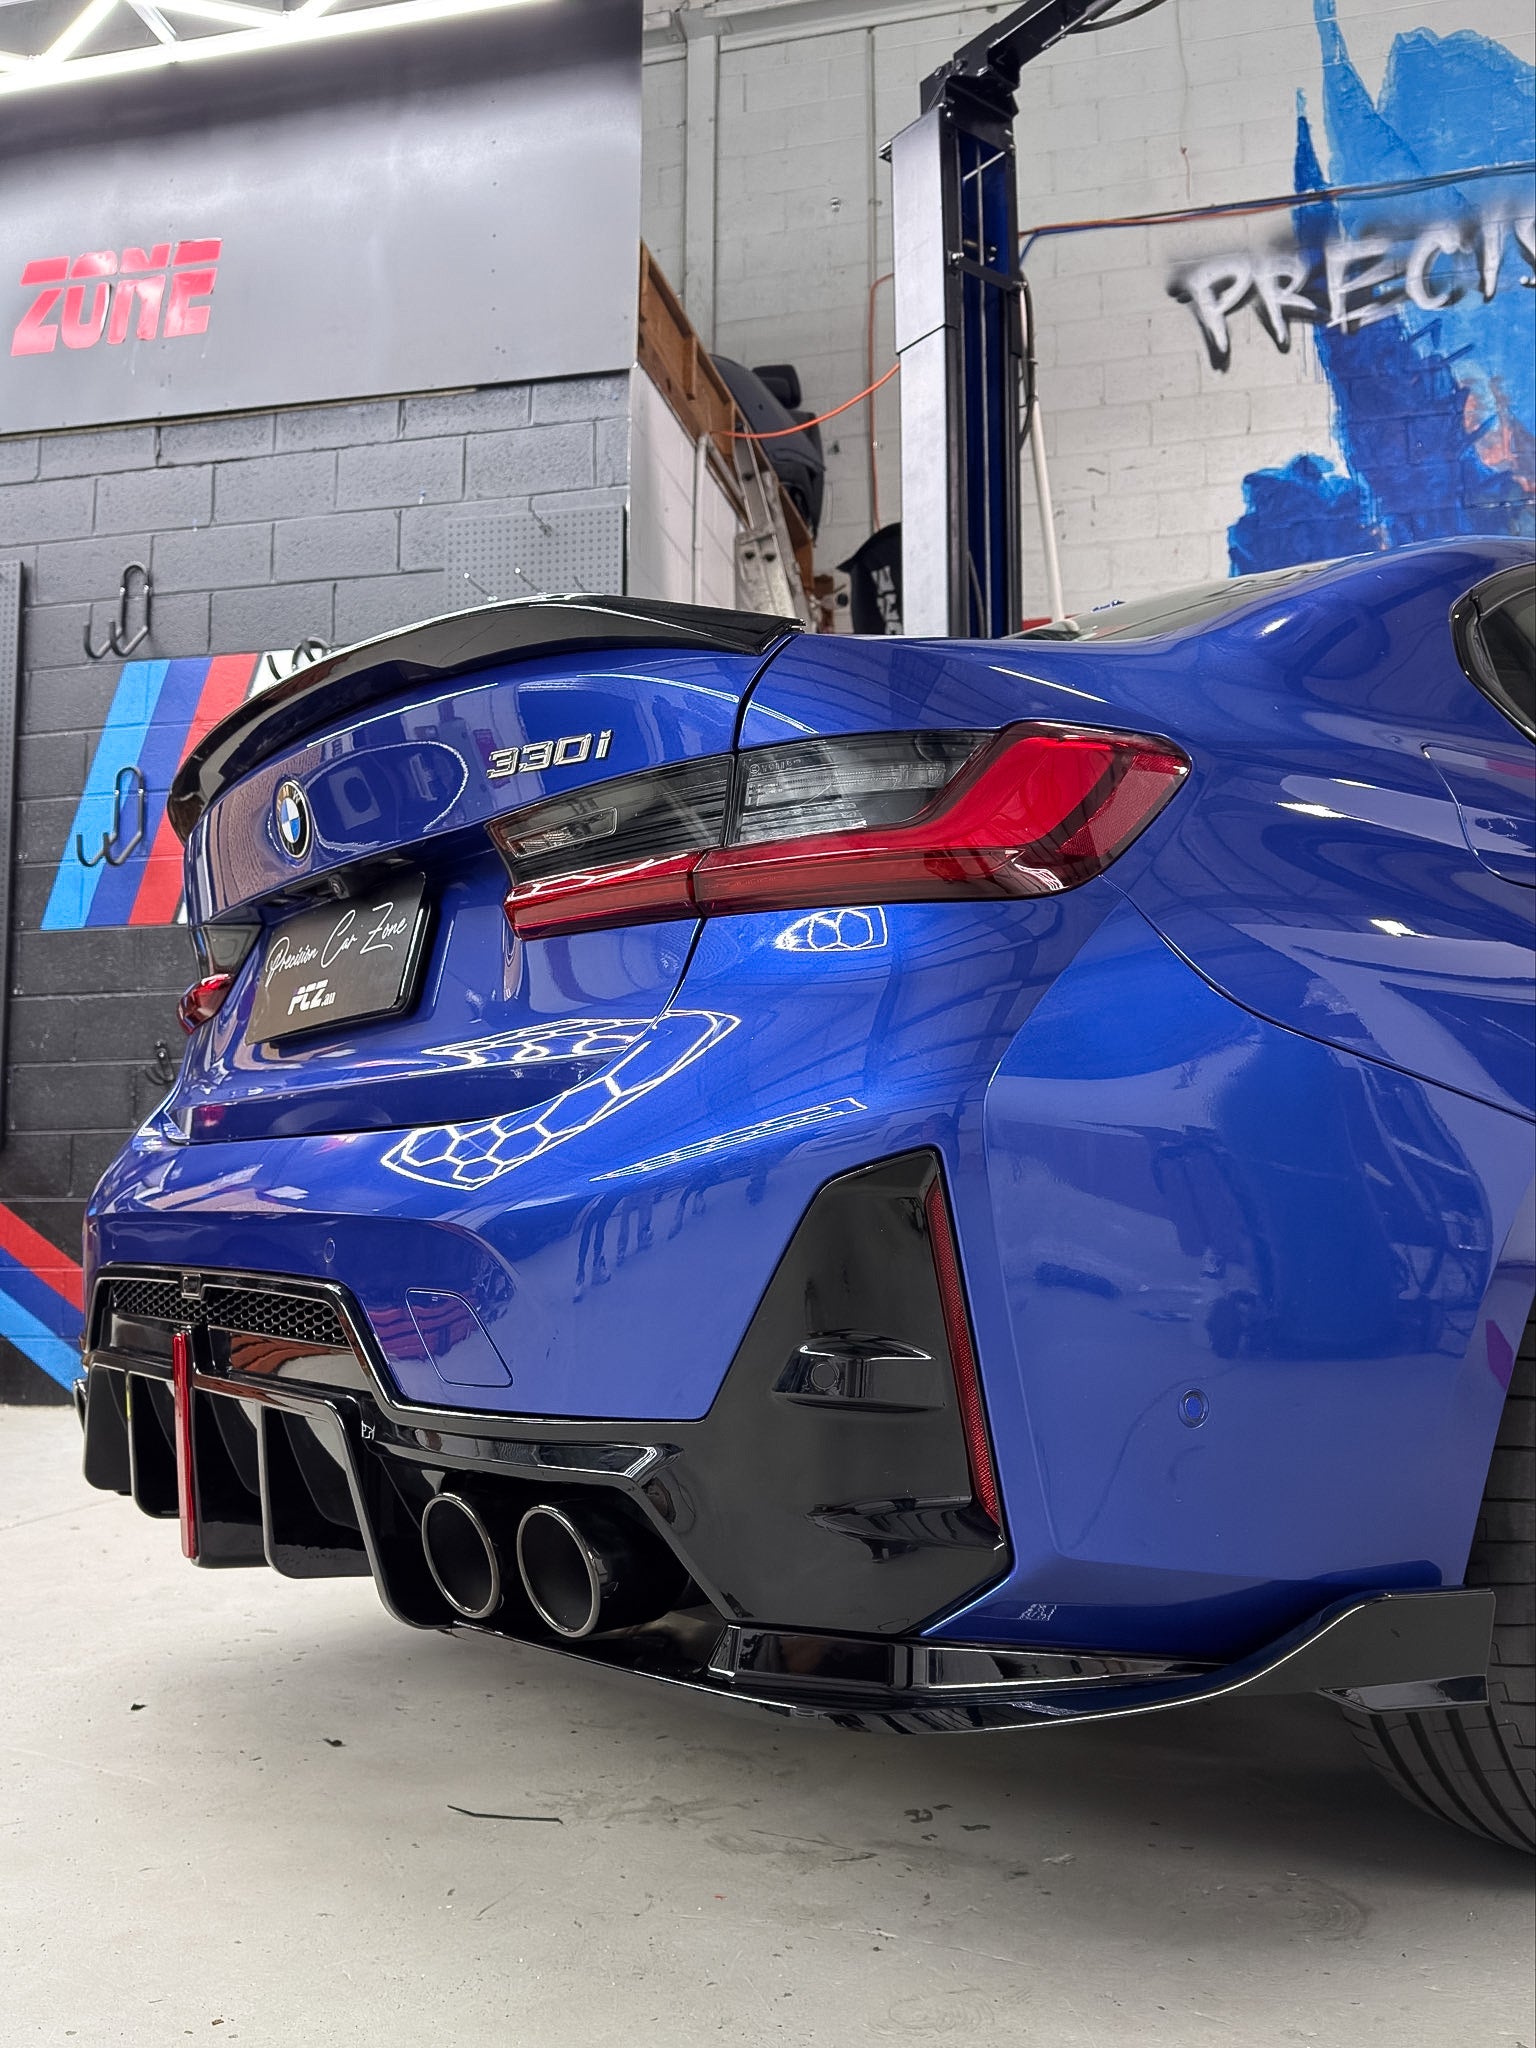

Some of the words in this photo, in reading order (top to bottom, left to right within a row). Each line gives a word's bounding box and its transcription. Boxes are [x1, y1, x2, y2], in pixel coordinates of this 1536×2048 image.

[11, 237, 222, 356] ZONE
[486, 729, 613, 779] 330i
[265, 936, 318, 987] Precision
[320, 909, 357, 968] Car
[360, 902, 407, 955] Zone
